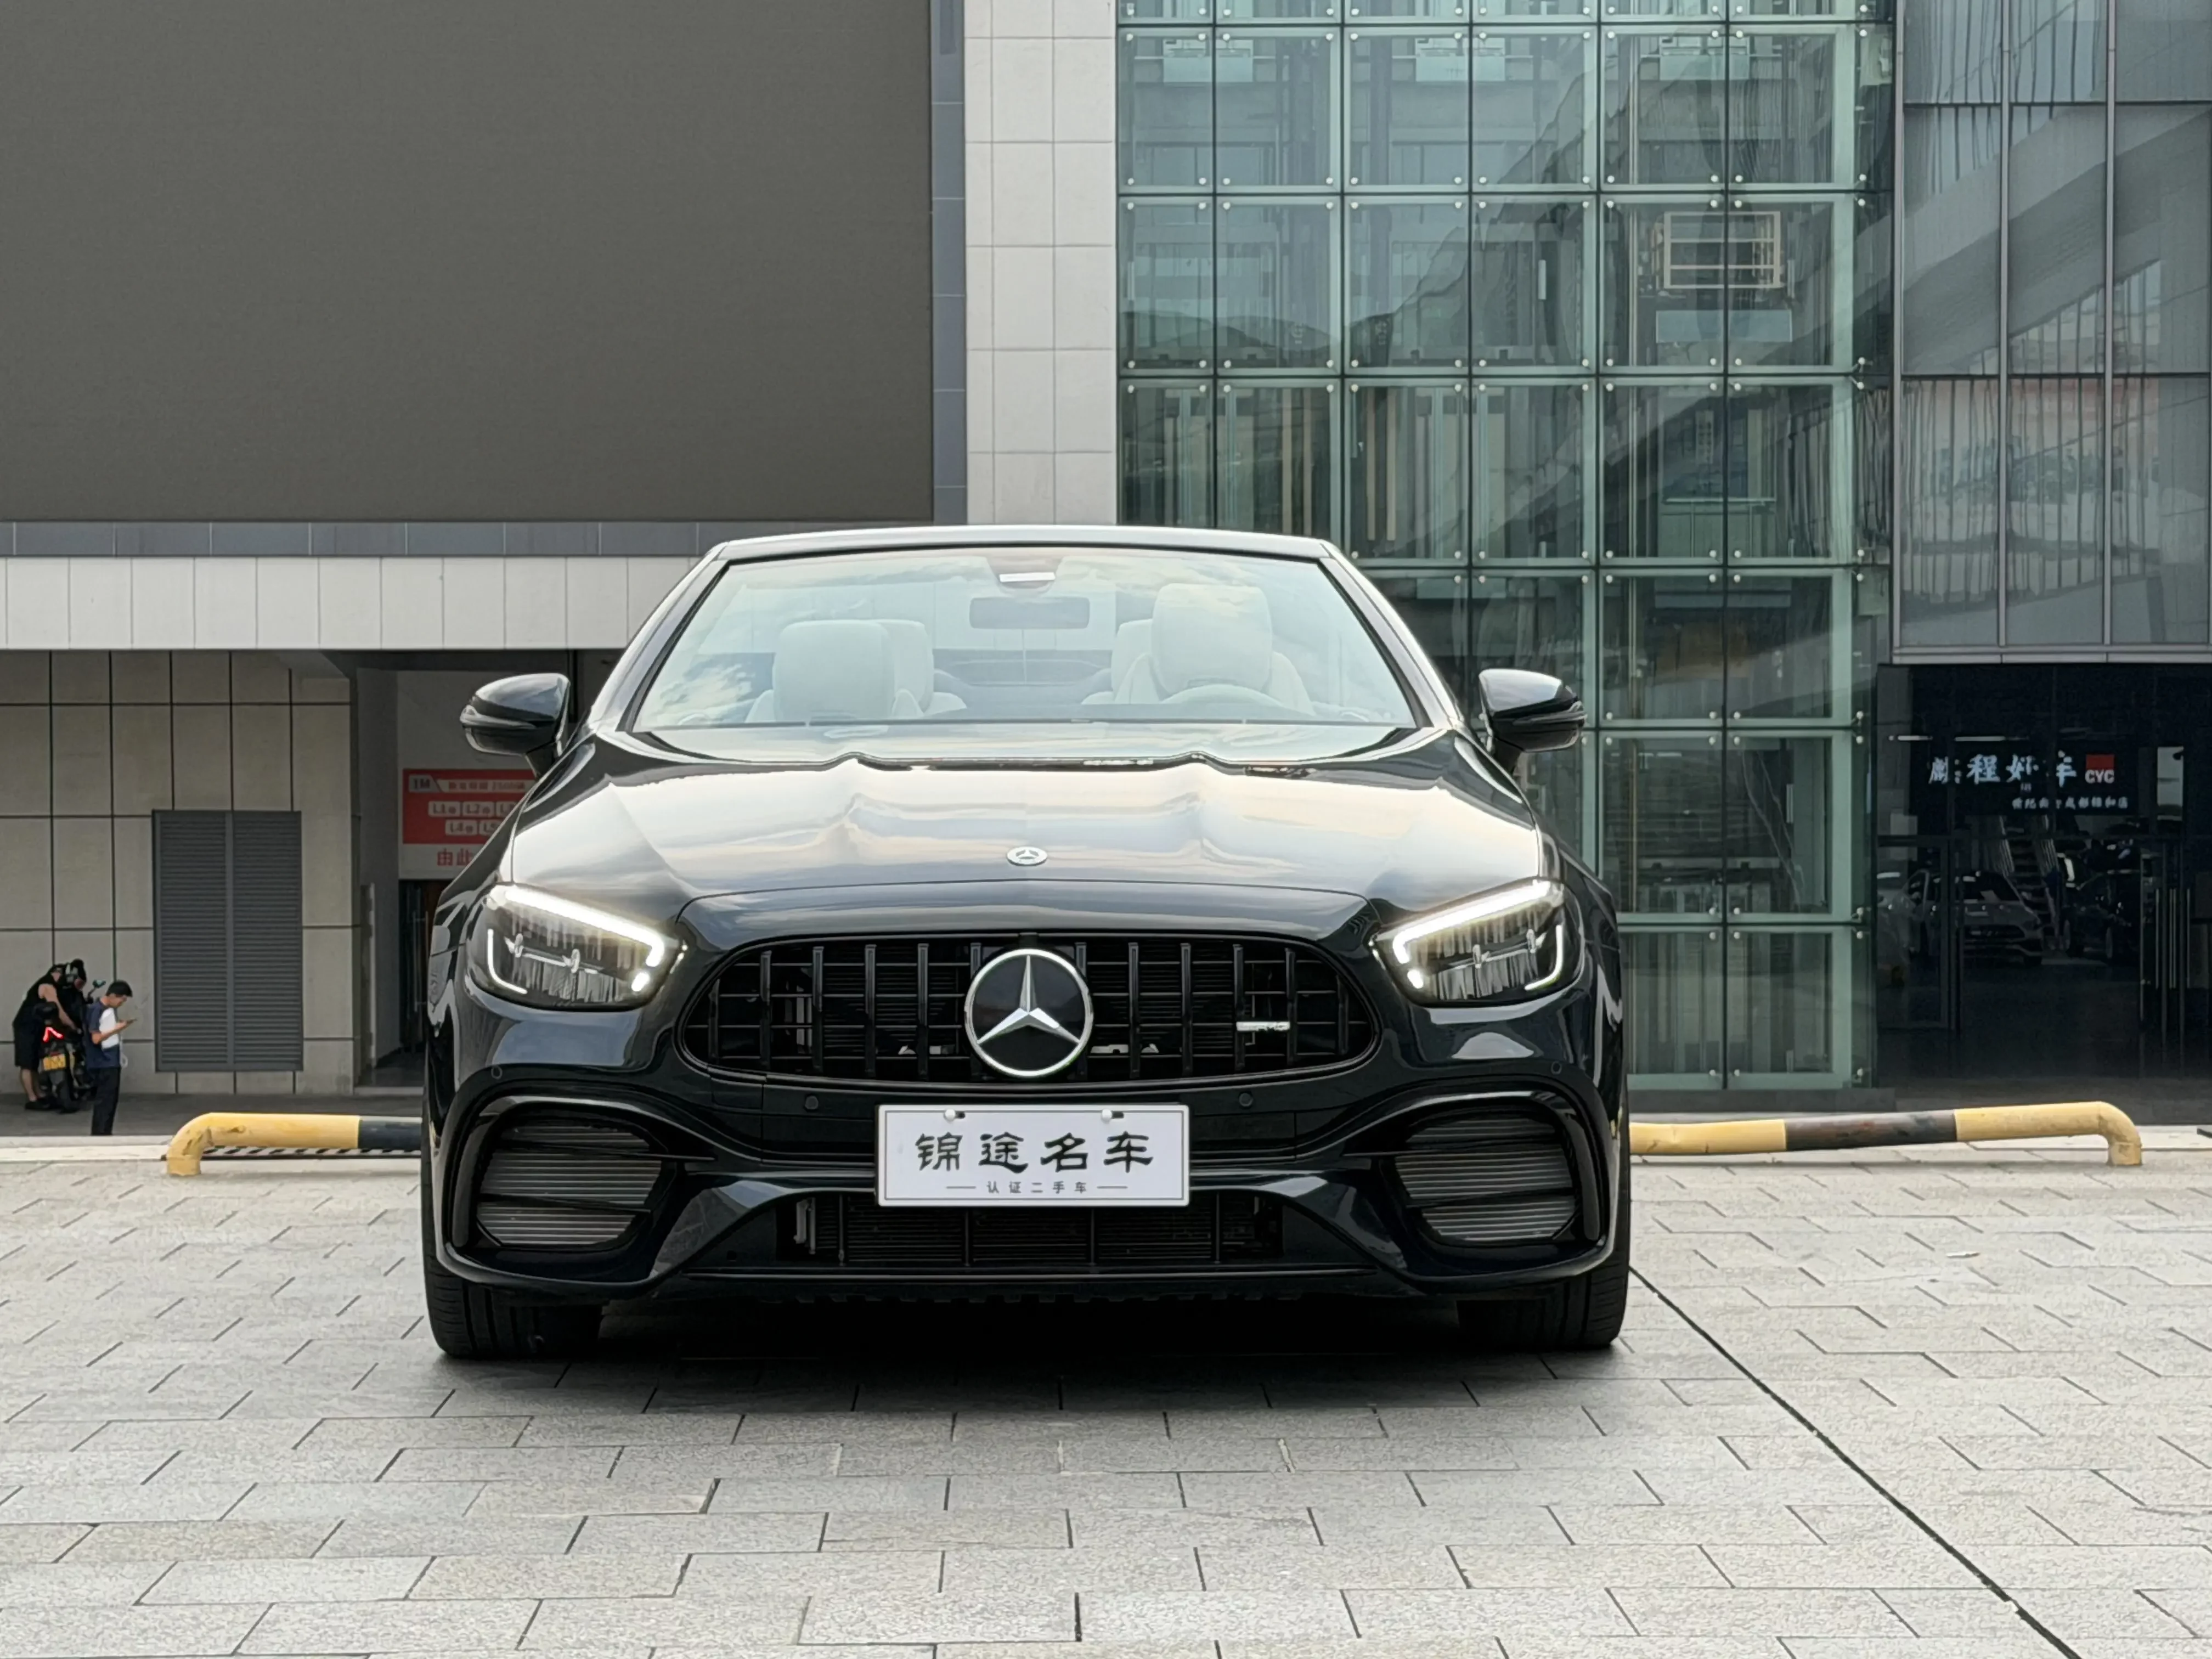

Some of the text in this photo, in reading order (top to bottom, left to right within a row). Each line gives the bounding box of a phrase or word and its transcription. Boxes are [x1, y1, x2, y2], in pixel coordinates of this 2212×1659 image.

[2084, 769, 2115, 784] CYC
[915, 1130, 1154, 1173] 锦途名车
[986, 1181, 1087, 1194] 认证二手车
